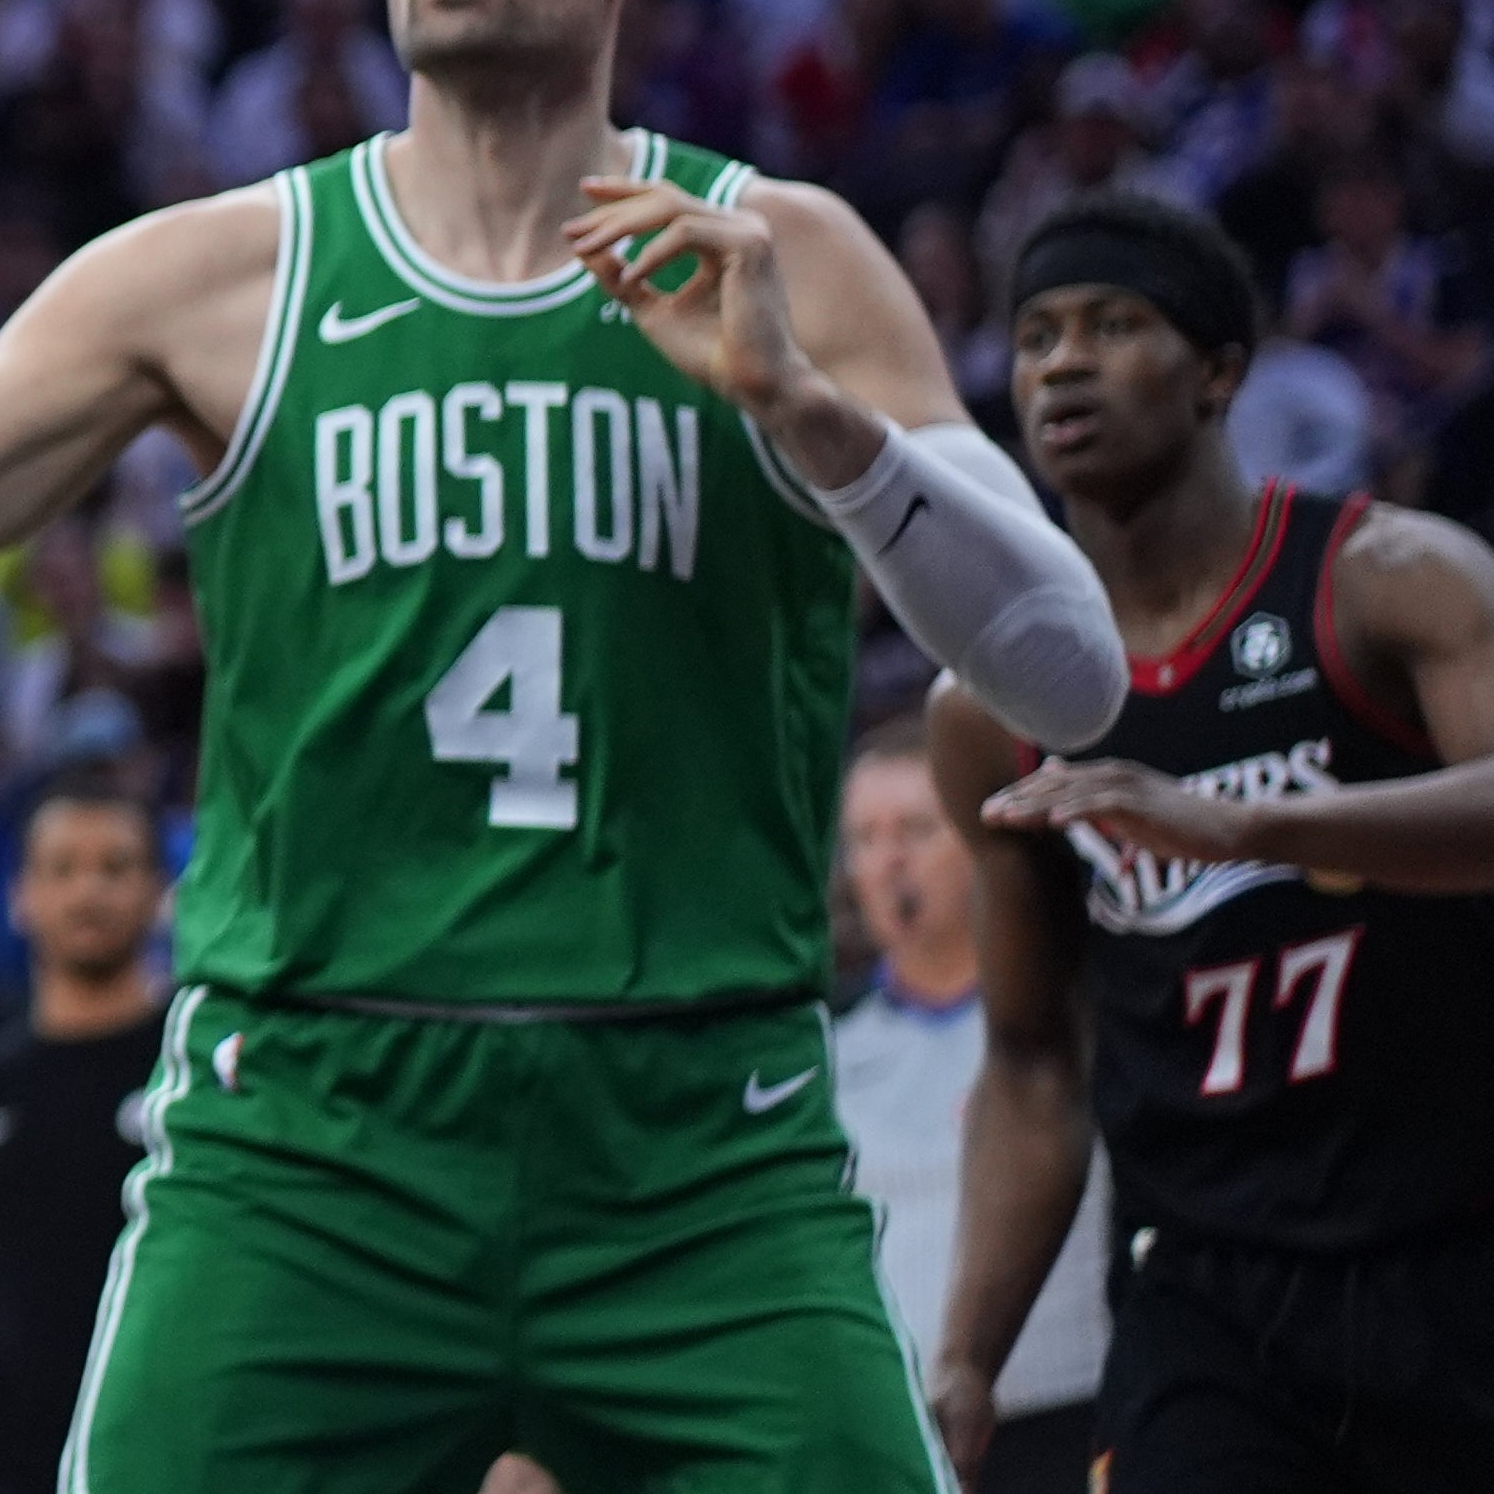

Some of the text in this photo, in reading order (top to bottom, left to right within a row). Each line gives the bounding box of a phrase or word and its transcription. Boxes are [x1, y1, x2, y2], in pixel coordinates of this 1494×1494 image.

[315, 380, 701, 586] BOSTON
[424, 604, 580, 832] 4
[1183, 924, 1365, 1098] 77
